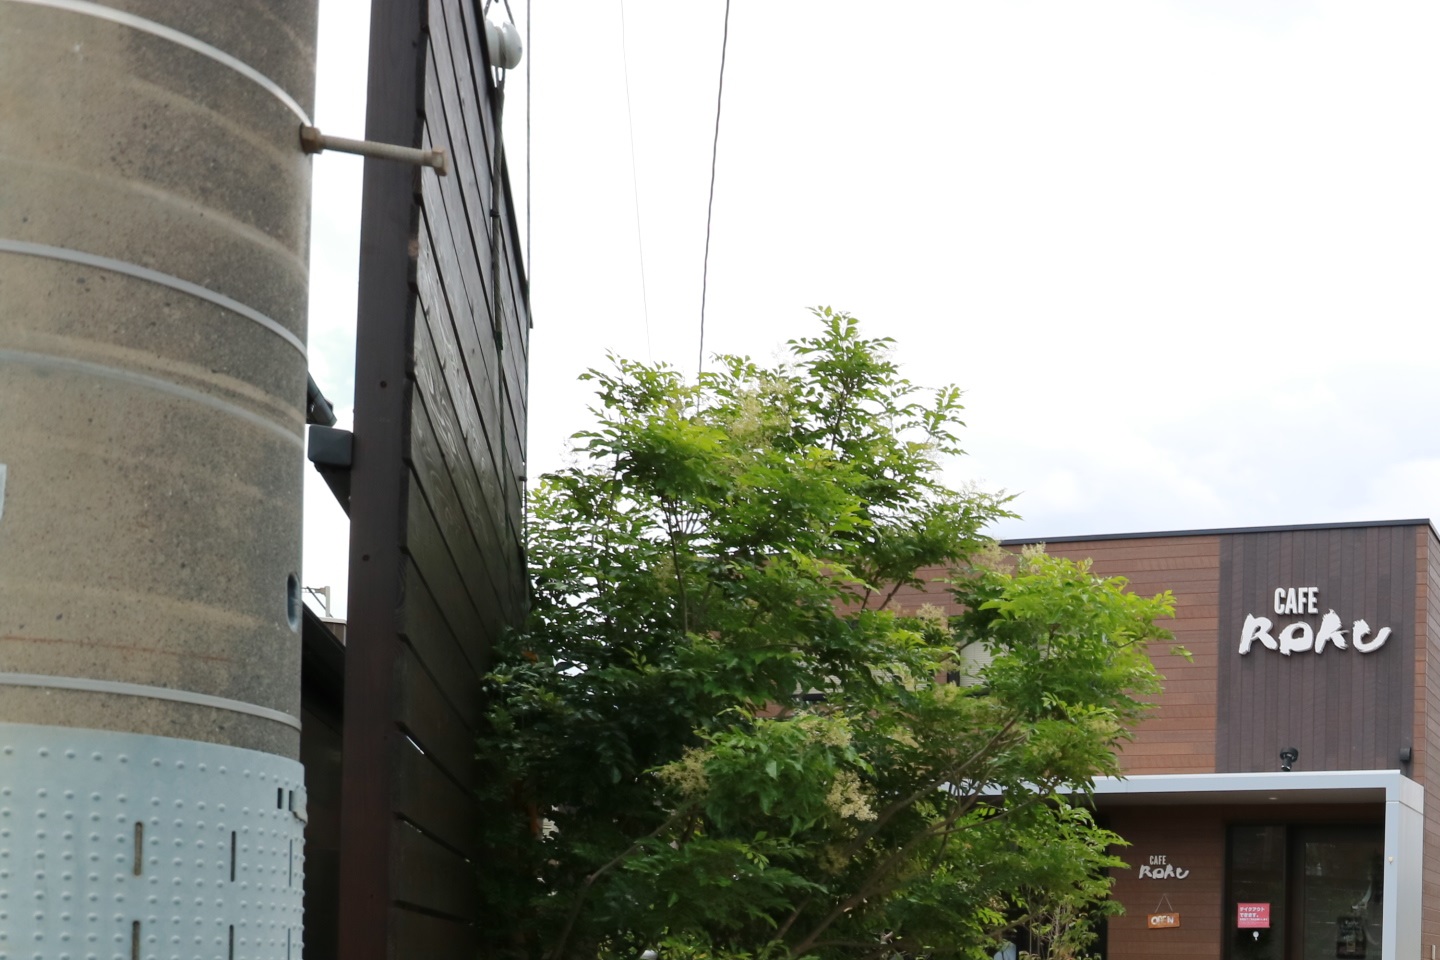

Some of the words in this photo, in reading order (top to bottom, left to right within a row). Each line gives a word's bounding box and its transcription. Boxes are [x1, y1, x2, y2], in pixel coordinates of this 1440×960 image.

[1274, 587, 1319, 615] CAFE
[1149, 855, 1167, 865] CAFE
[1150, 915, 1174, 925] OPEN
